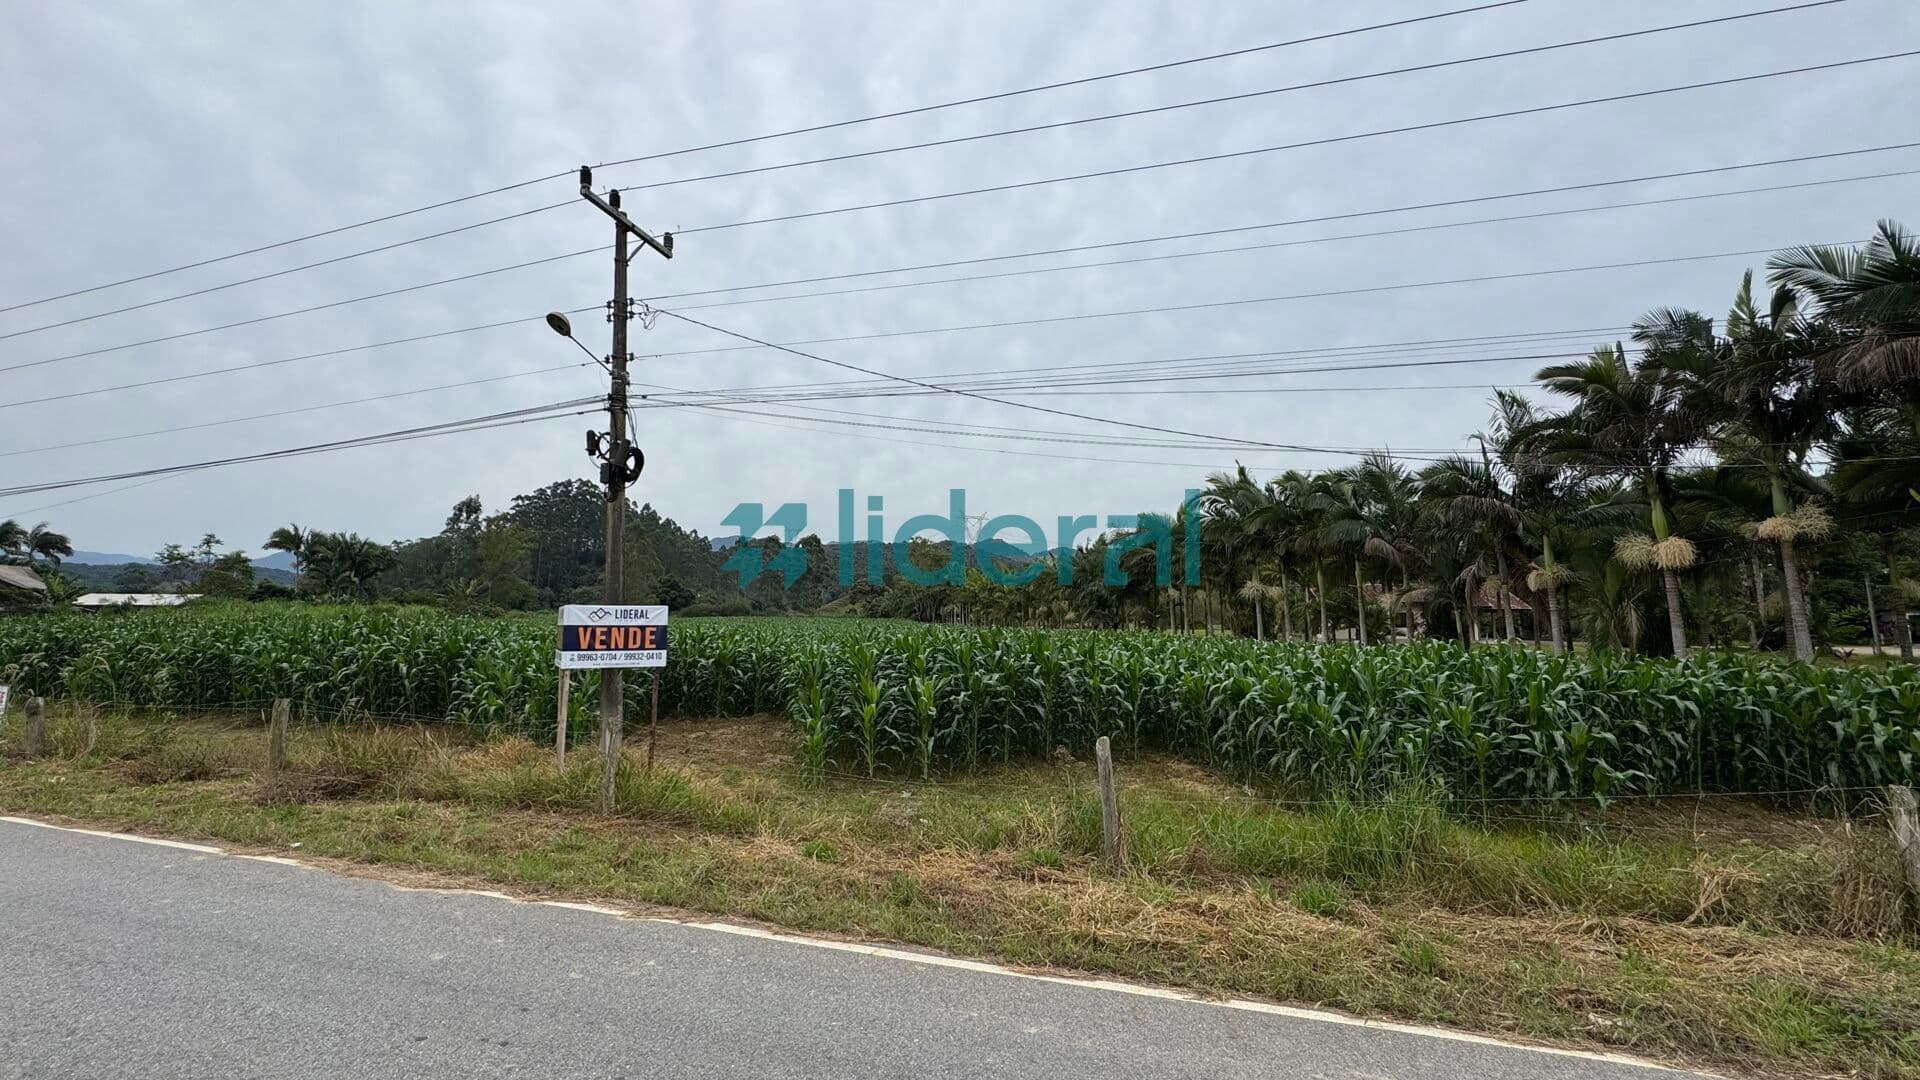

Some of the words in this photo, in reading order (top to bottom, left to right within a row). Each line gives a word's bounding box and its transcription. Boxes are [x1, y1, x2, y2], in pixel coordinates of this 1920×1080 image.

[615, 609, 650, 620] LIDERAL
[577, 627, 657, 650] VENDE
[577, 653, 617, 662] 99963-0704
[624, 652, 662, 661] 99932-0410
